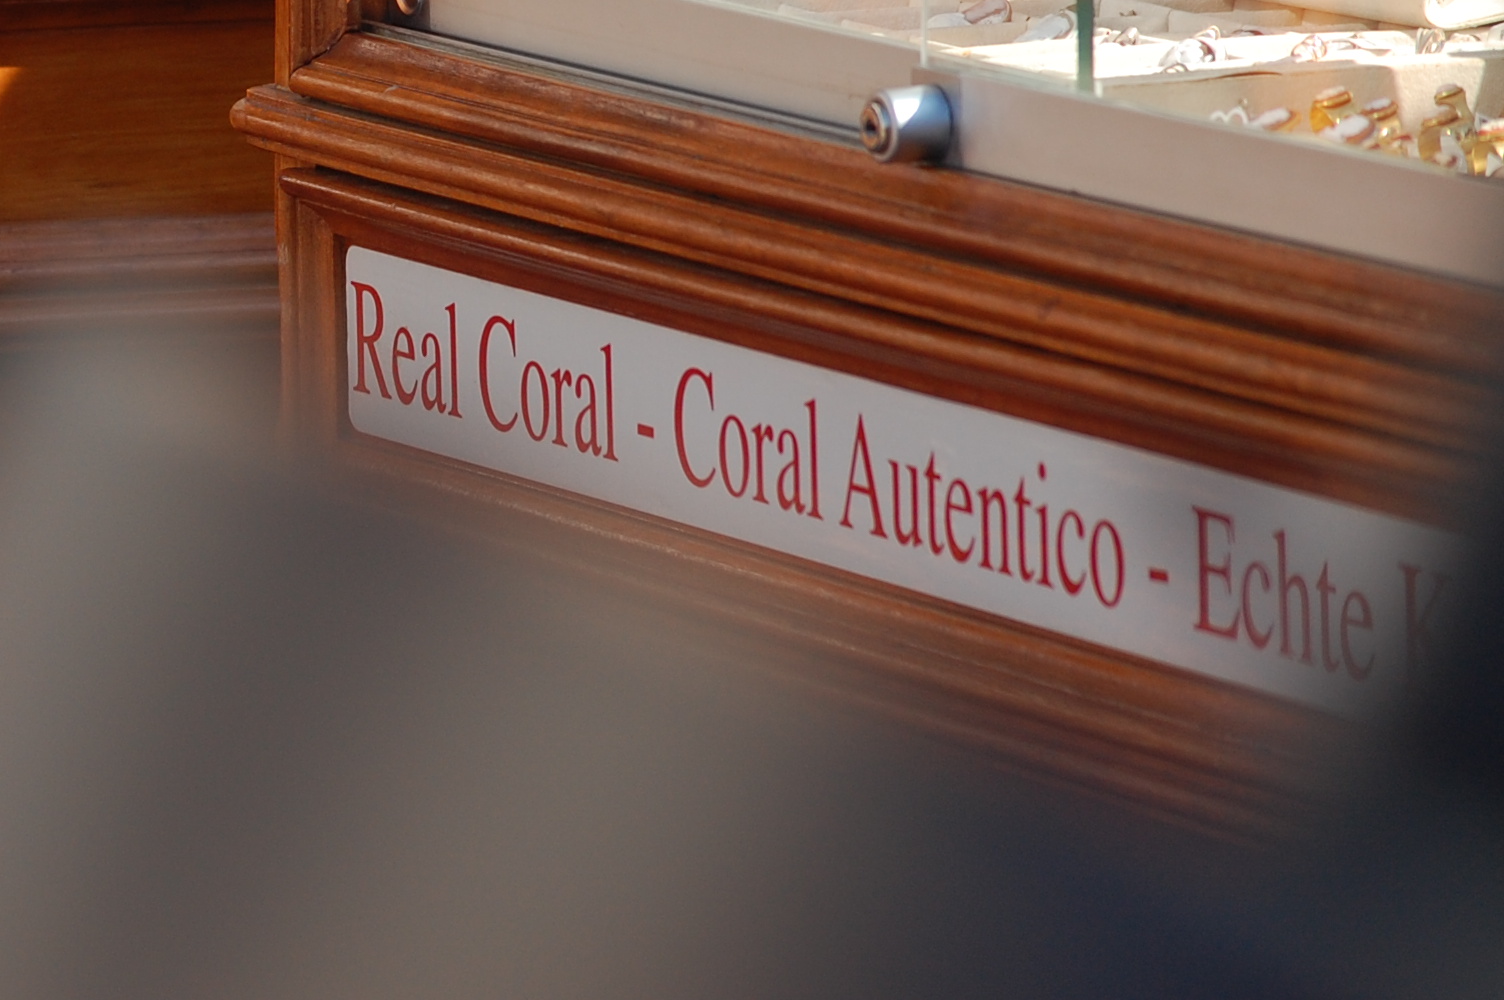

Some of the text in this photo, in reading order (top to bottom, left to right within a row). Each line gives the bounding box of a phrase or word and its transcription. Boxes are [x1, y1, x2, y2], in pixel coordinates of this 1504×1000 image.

[351, 280, 463, 420] Real
[478, 314, 619, 462] Coral
[637, 421, 656, 439] -
[674, 366, 826, 521] Coral
[839, 412, 1126, 609] Autentico
[1148, 567, 1170, 584] -
[1192, 504, 1376, 682] Echte
